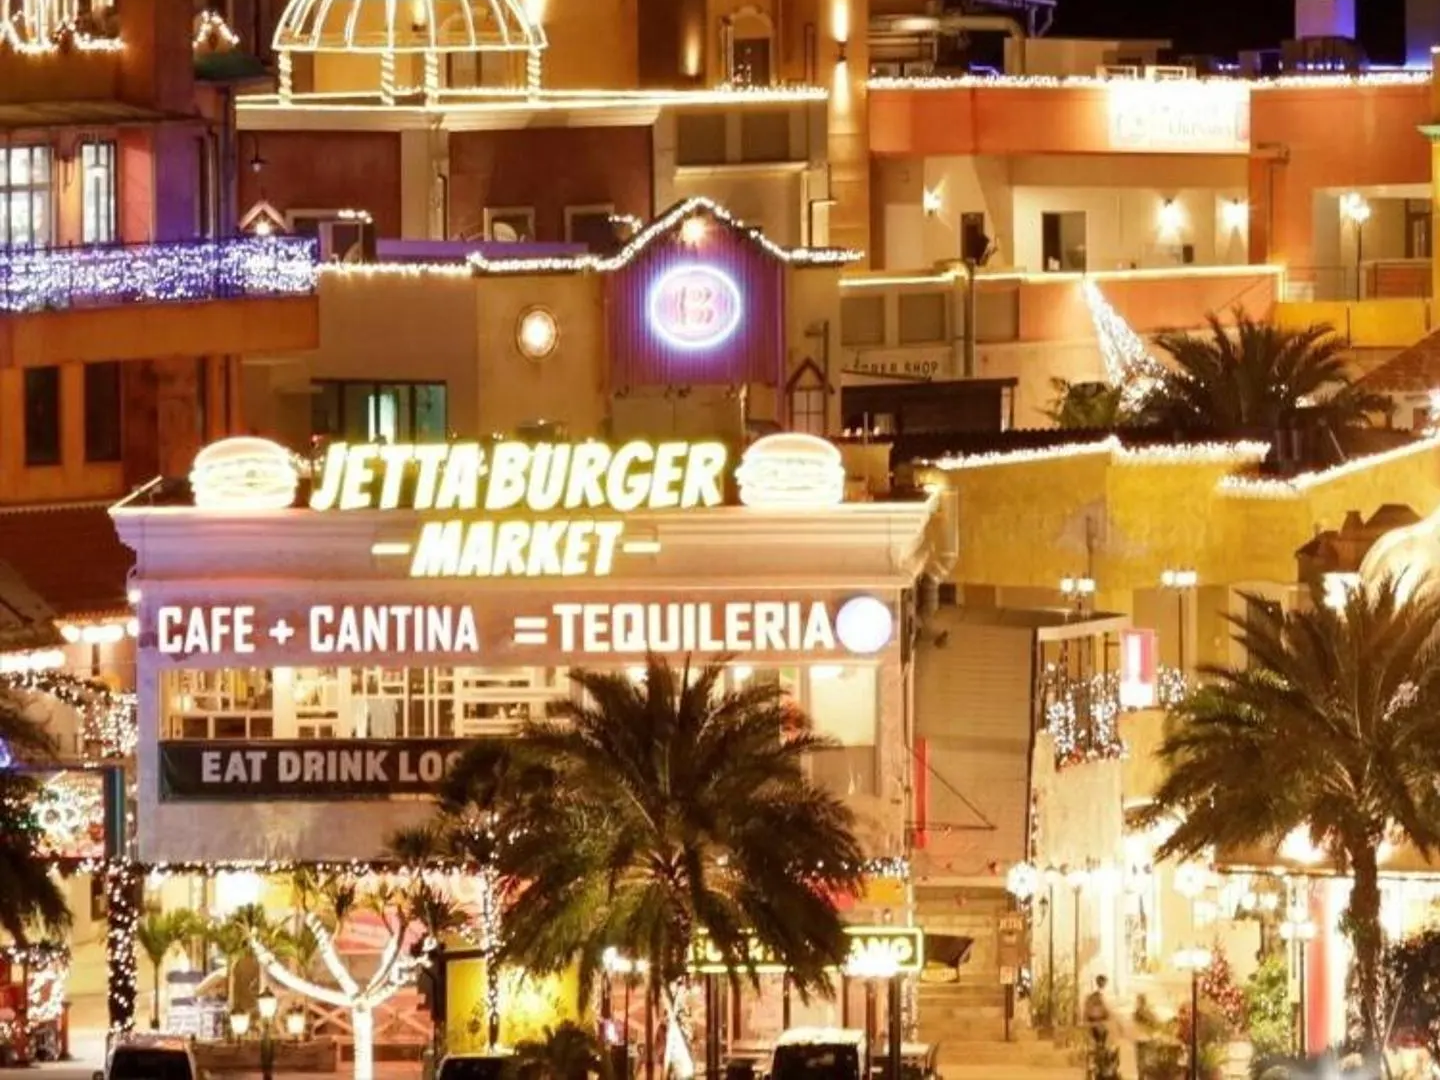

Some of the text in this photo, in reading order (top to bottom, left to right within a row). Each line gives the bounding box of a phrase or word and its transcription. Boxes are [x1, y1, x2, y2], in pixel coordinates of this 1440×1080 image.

[310, 440, 727, 512] JETTA BURGER
[410, 519, 625, 577] MARKET
[157, 605, 254, 653] CAFE
[310, 606, 479, 653] CANTINA
[553, 602, 836, 653] TEQUILERIA
[201, 750, 267, 782] EAT
[278, 750, 388, 782] DRINK
